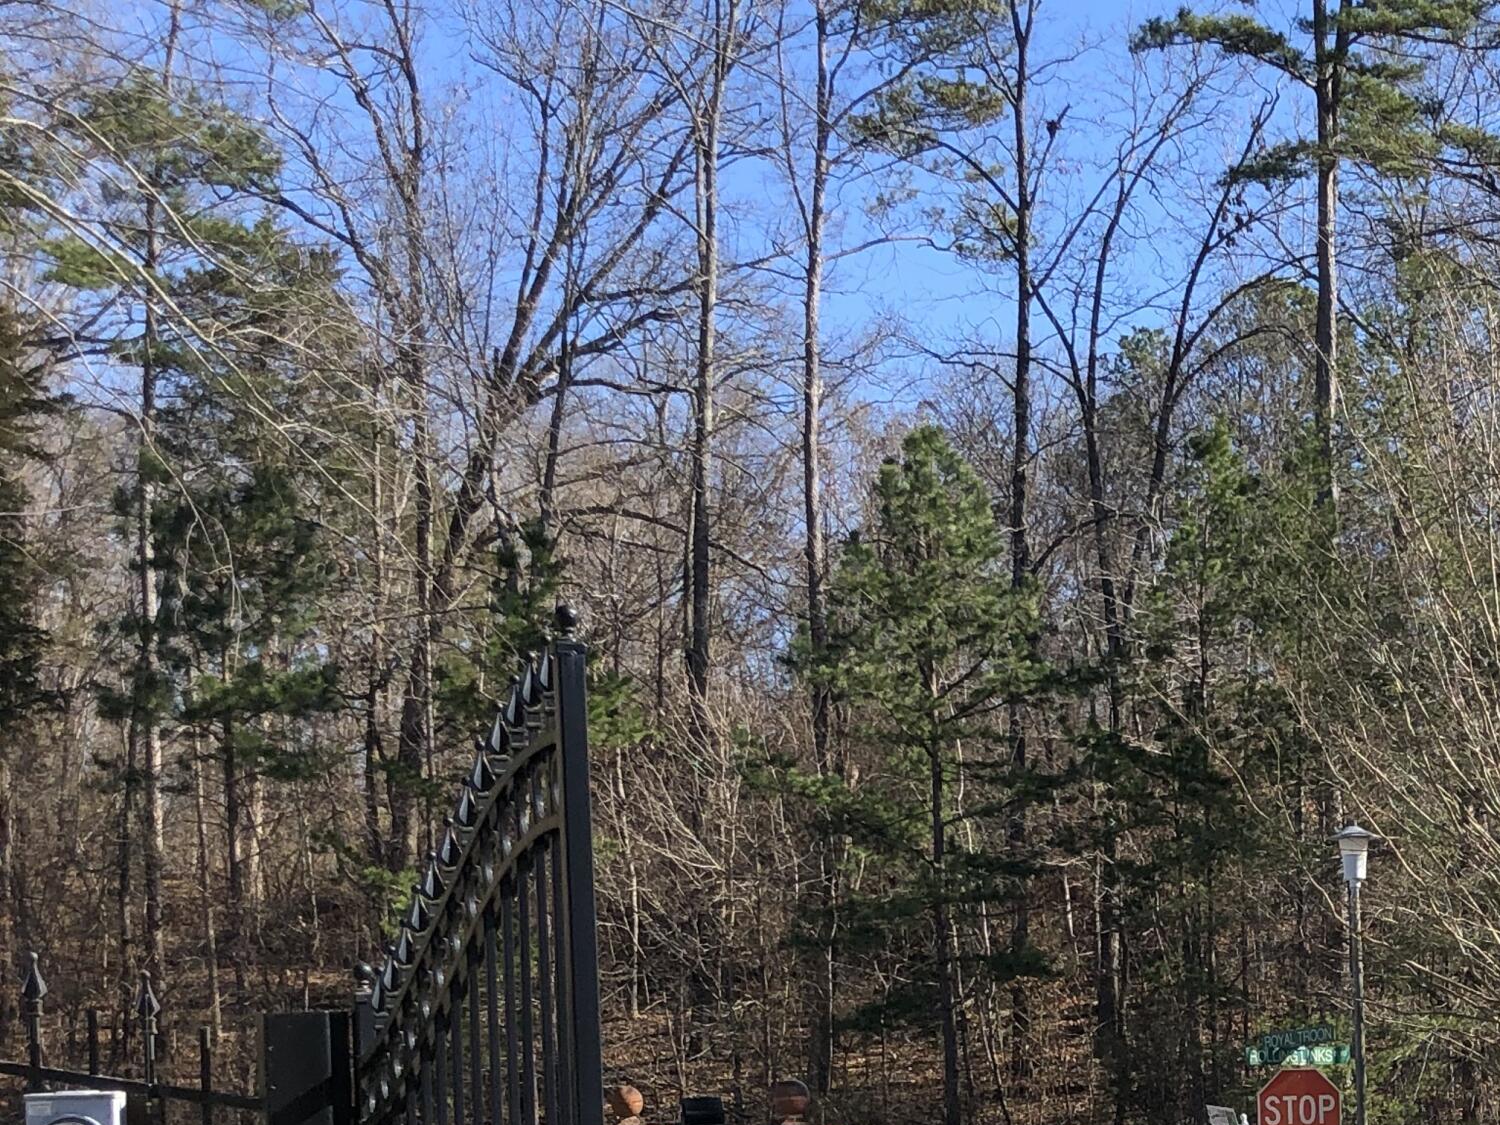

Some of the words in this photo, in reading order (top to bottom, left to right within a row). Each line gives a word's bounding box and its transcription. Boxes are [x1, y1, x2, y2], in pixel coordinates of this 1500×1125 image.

[1265, 1033, 1295, 1047] ROYAL
[1297, 1028, 1333, 1043] TROON
[1299, 1048, 1333, 1062] LINKS
[1264, 1094, 1336, 1125] STOP
